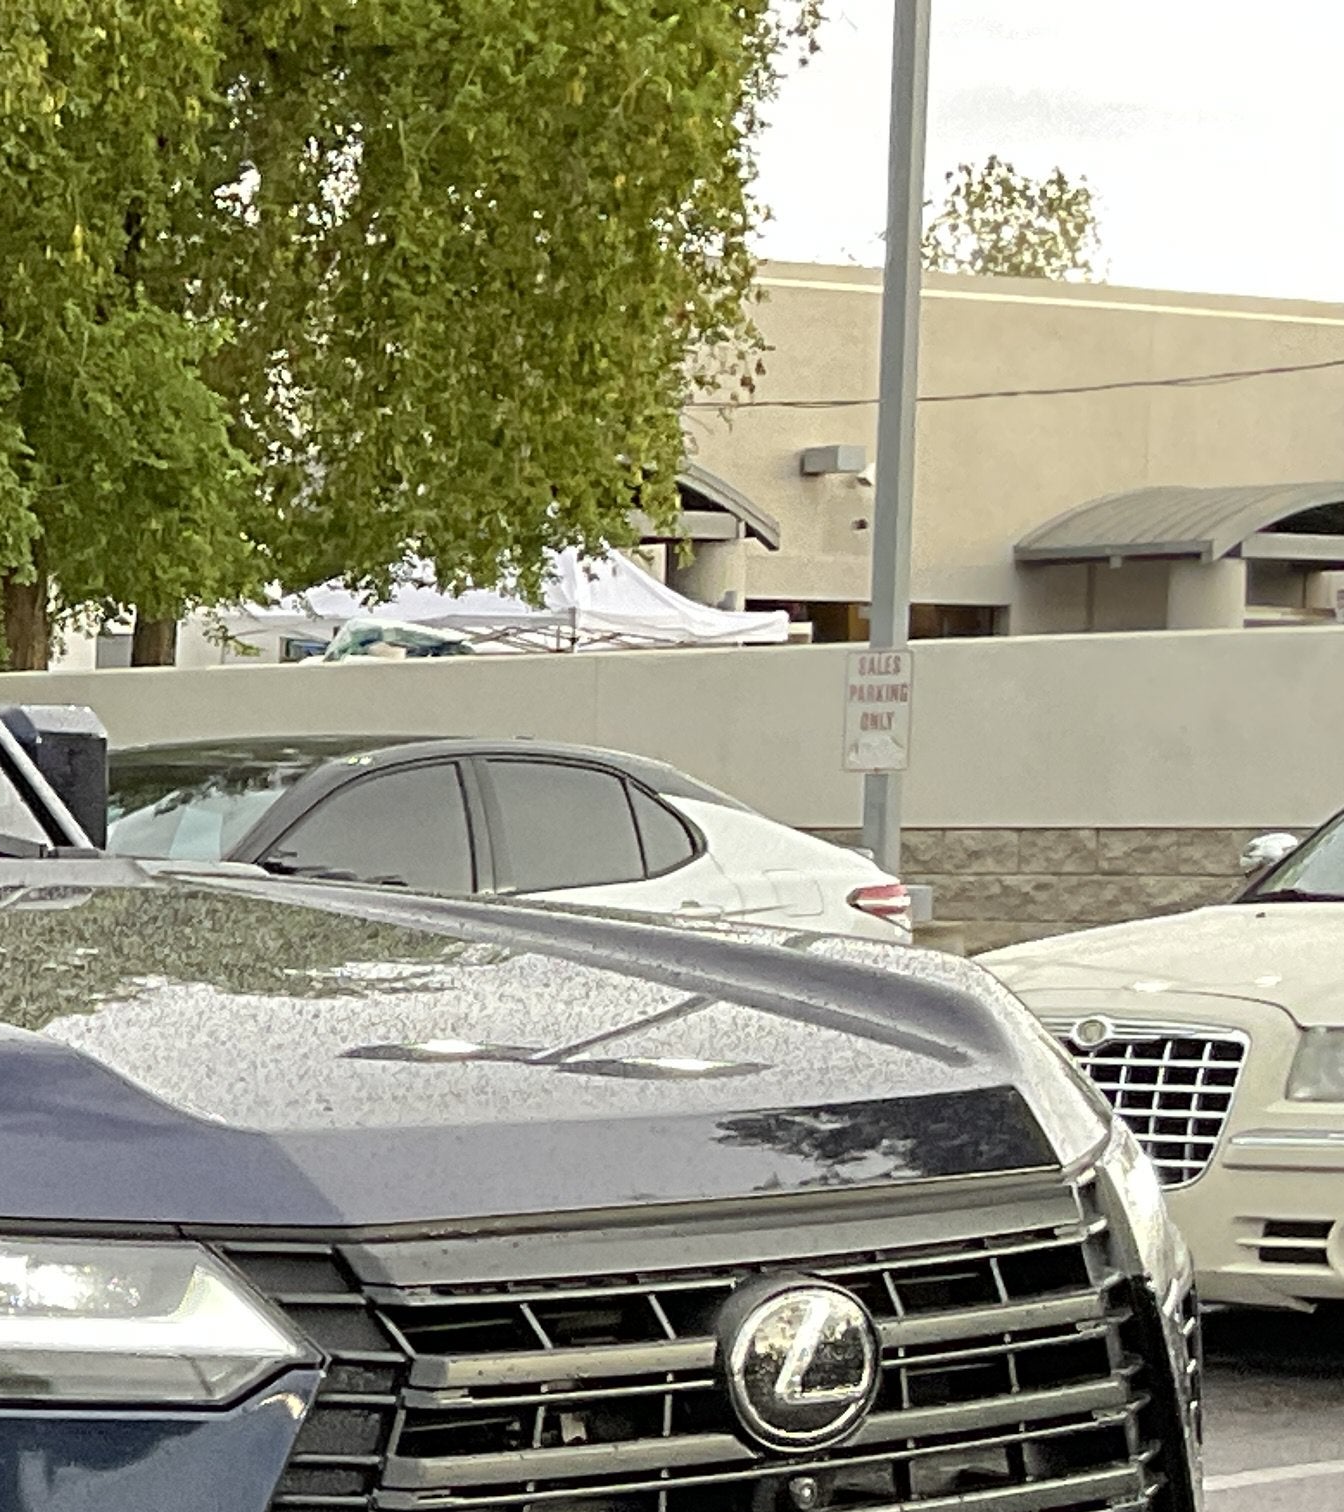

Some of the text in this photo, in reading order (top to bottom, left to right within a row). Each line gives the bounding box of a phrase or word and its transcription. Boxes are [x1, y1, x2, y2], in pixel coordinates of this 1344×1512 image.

[858, 655, 902, 676] SALES
[849, 683, 909, 703] PARKING
[859, 711, 895, 731] ONLY
